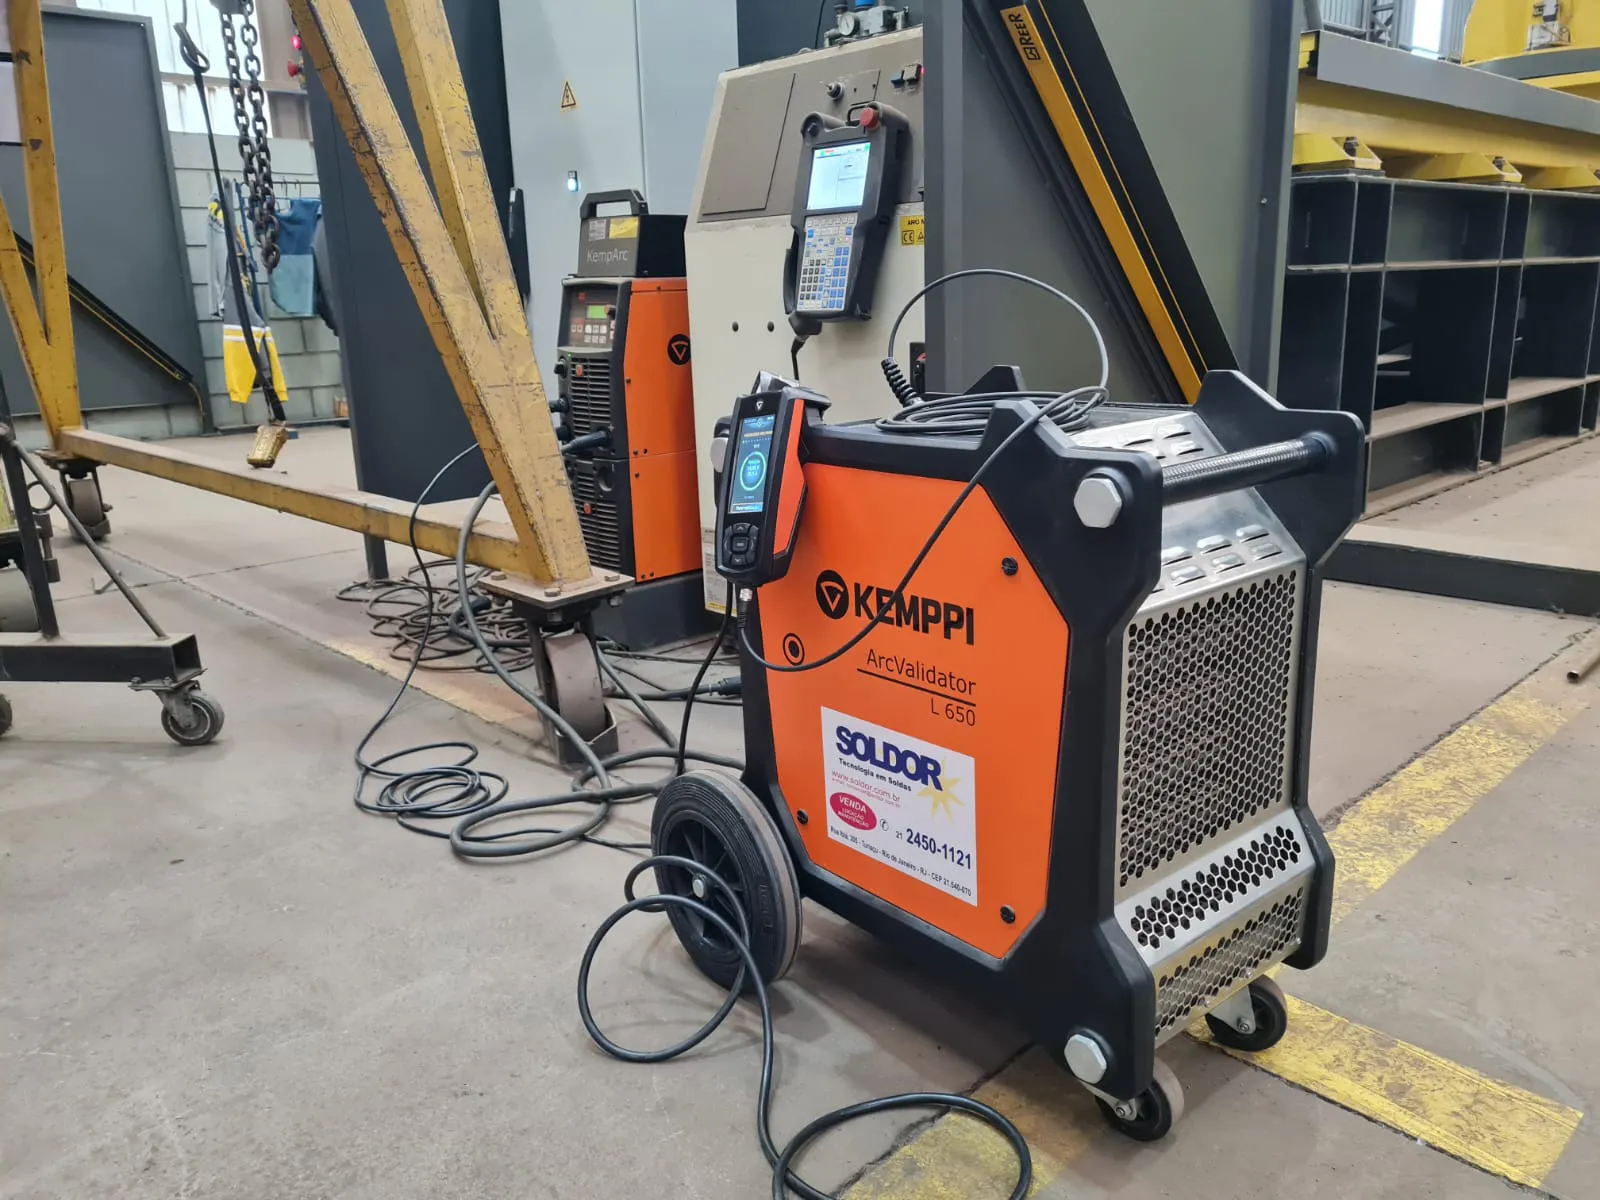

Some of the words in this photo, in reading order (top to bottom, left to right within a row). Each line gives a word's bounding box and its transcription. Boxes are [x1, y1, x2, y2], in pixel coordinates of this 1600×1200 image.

[1008, 13, 1034, 46] REER
[587, 248, 629, 264] KempArc
[854, 582, 974, 646] KEMPPI
[867, 648, 976, 695] ArcValidator
[931, 698, 939, 715] L
[945, 704, 976, 726] 650
[835, 725, 943, 792] SOLDOR
[838, 757, 875, 778] Tecnologia
[875, 773, 887, 783] em
[888, 777, 912, 792] Soldas
[838, 795, 867, 814] VENDA
[895, 830, 903, 840] 21
[906, 828, 971, 870] 2450-1121
[931, 872, 942, 883] CEP
